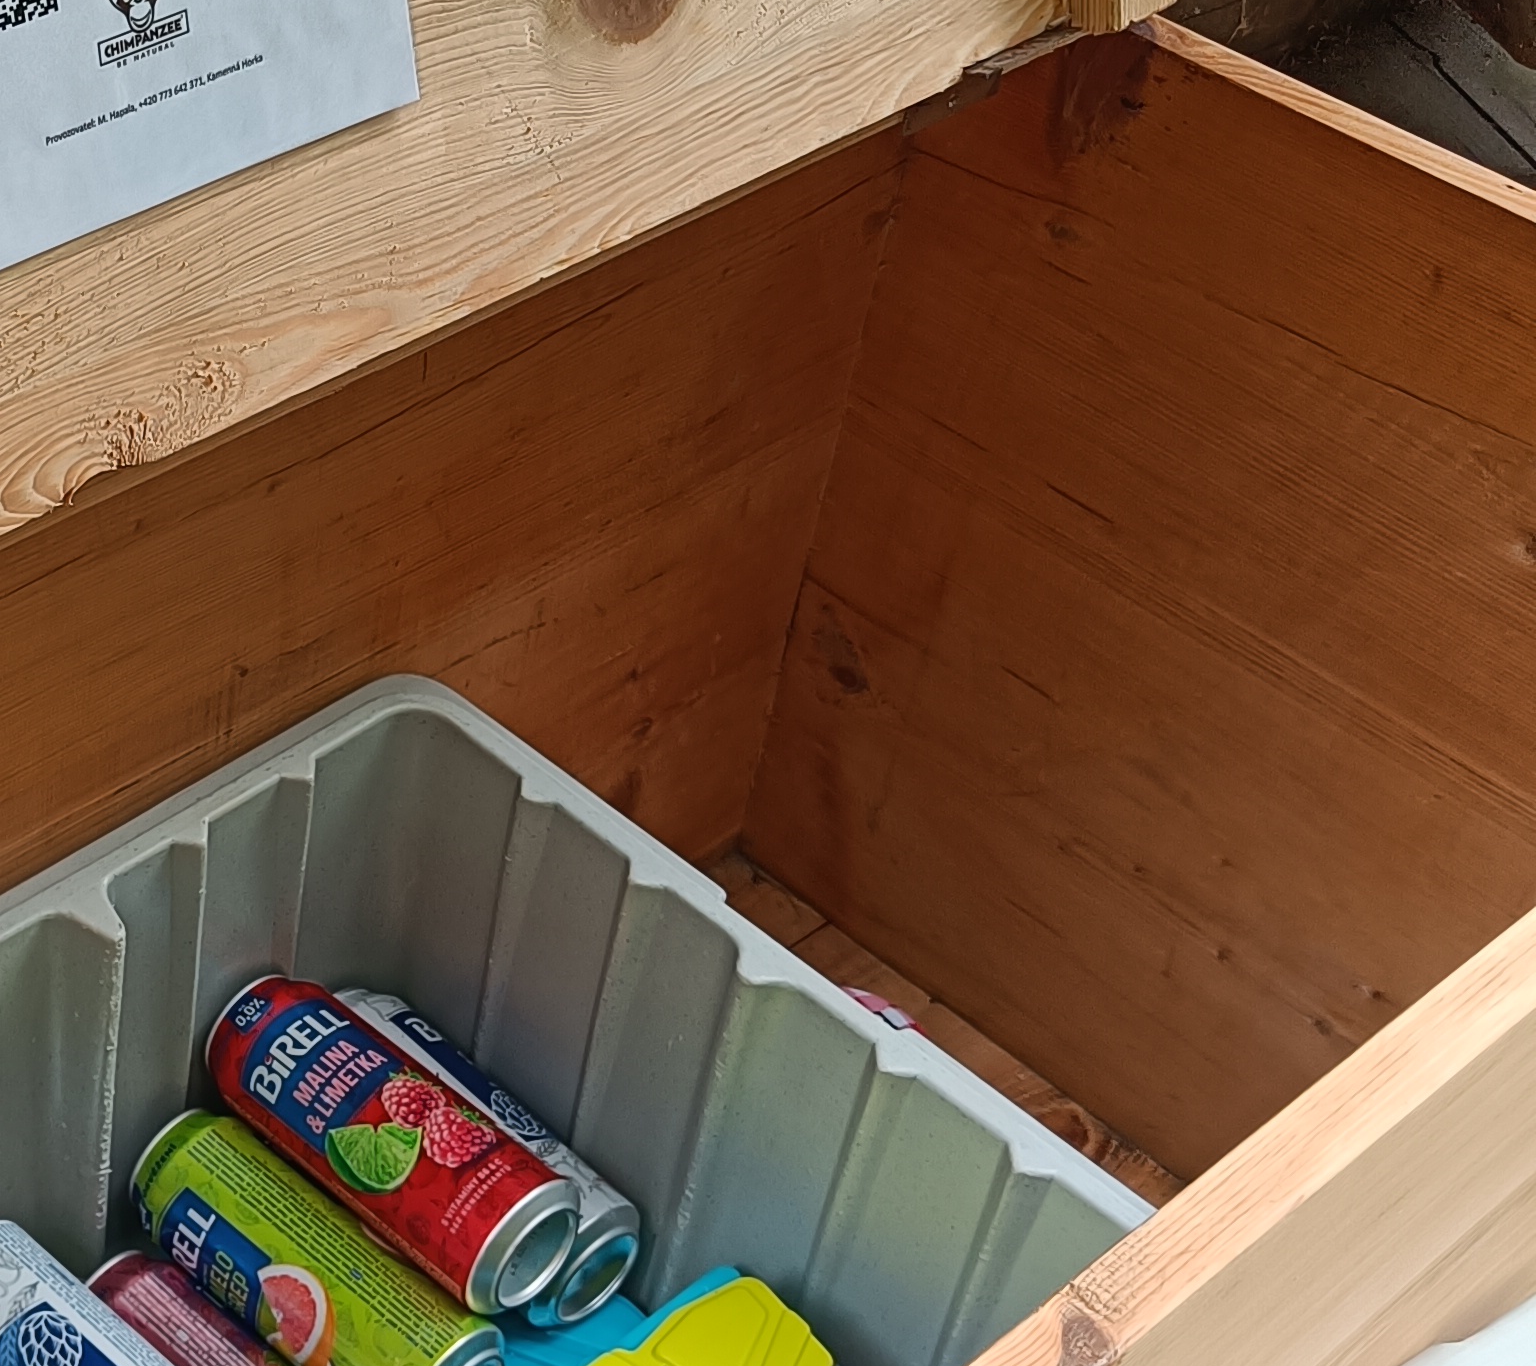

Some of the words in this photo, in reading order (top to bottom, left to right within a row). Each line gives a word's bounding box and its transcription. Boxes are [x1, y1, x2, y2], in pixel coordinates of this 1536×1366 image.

[133, 41, 175, 62] NATURAL
[97, 114, 109, 126] M.
[138, 93, 158, 108] +420
[158, 88, 173, 102] 773
[173, 82, 188, 96] 642
[206, 60, 241, 83] Kamenná
[293, 1040, 359, 1107] MALINA
[314, 1050, 388, 1117] LIMETKA
[306, 1115, 325, 1133] &
